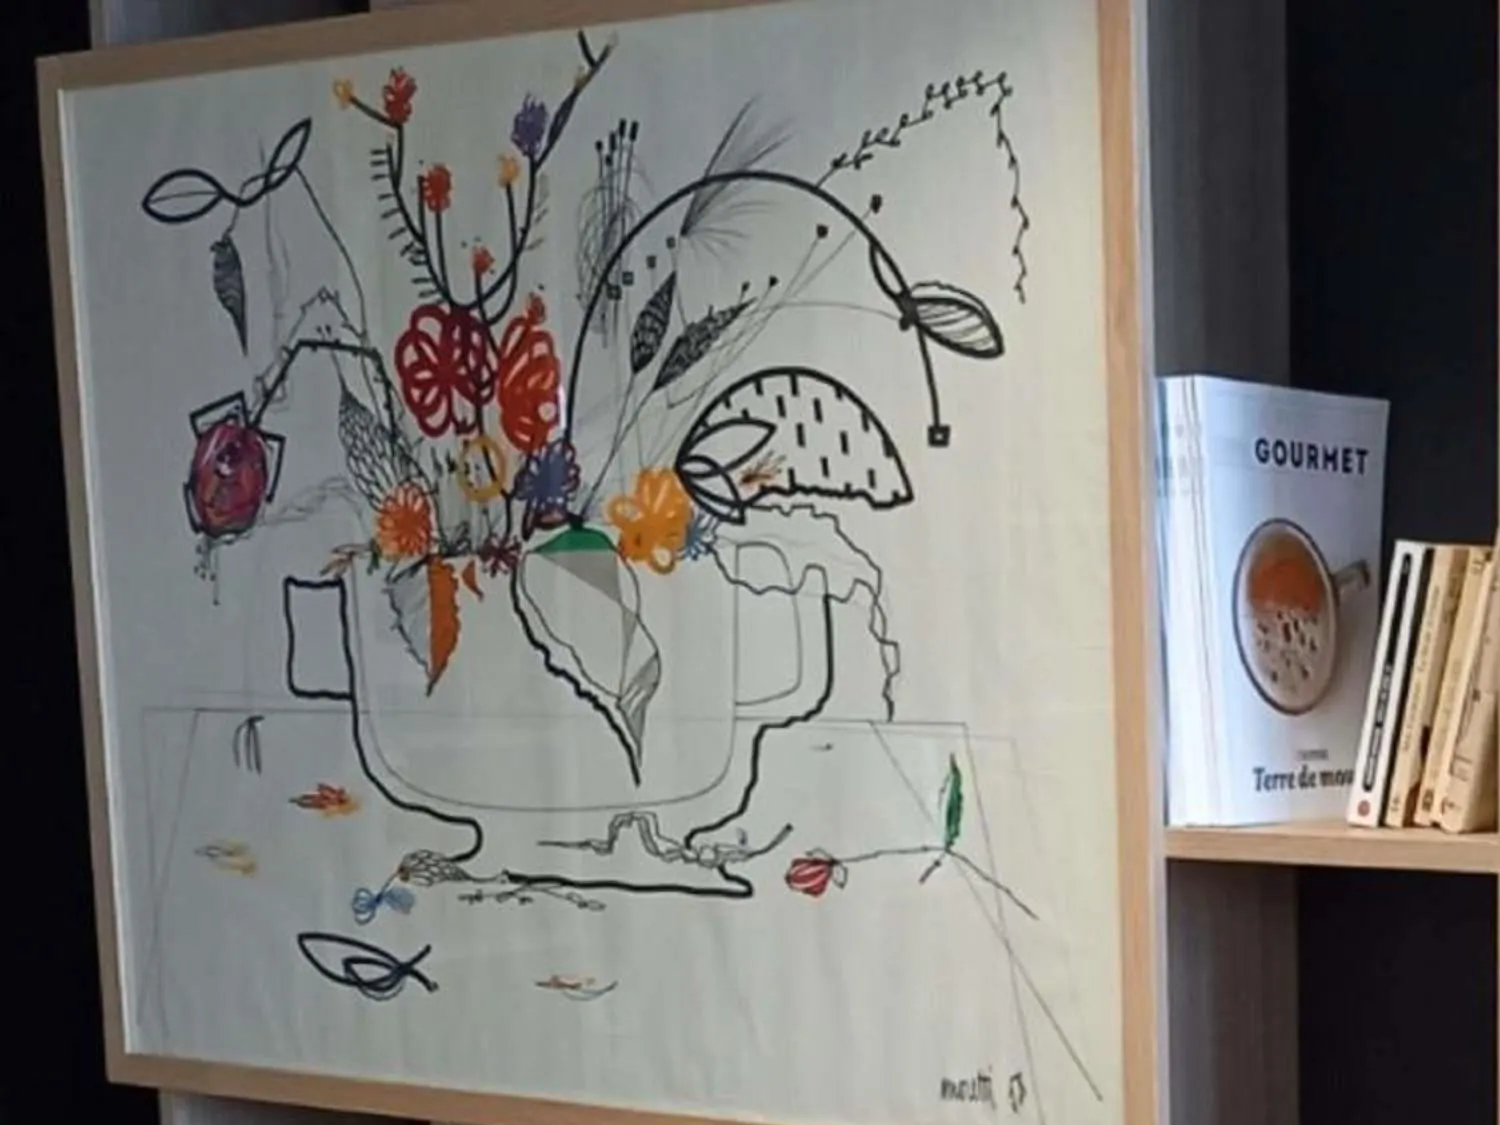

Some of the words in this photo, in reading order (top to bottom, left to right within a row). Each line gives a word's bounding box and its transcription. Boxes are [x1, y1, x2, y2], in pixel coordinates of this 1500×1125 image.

[1254, 436, 1370, 476] GOURMET
[1252, 766, 1297, 793] Terre
[1297, 763, 1317, 790] de
